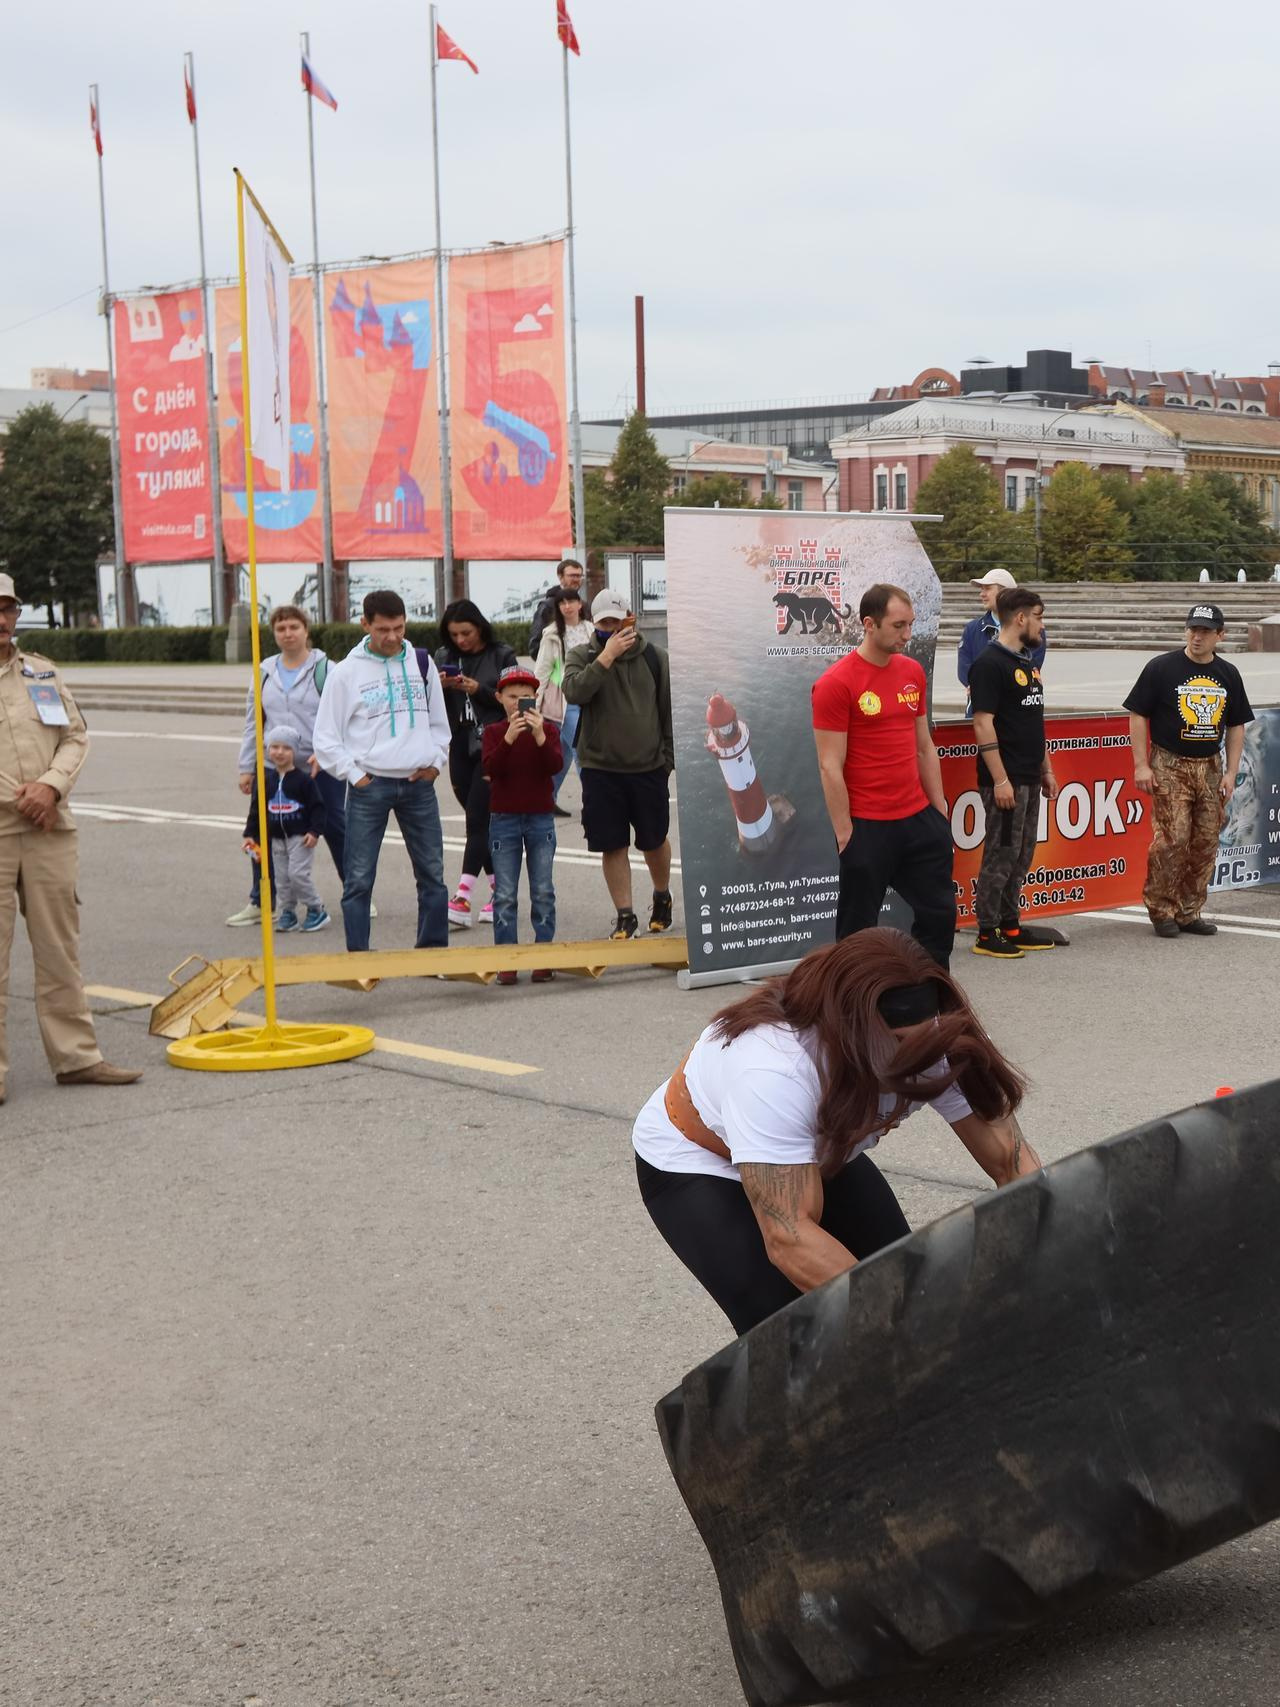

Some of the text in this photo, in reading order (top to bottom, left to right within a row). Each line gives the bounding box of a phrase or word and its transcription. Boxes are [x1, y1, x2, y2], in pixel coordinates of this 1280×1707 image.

[132, 382, 196, 415] С днём
[135, 426, 202, 457] города,
[136, 462, 205, 499] туляки!
[1271, 785, 1279, 794] г.
[1269, 808, 1275, 820] 8
[1109, 857, 1126, 875] 30
[721, 884, 757, 896] 300013,
[758, 880, 788, 893] г.Тула,
[1033, 886, 1085, 906] 36-01-42
[719, 890, 840, 914] +7(4872)24-68-12 +7(4872)
[720, 916, 786, 933] info@barsco.ru,
[721, 931, 812, 951] www. bars-security.ru
